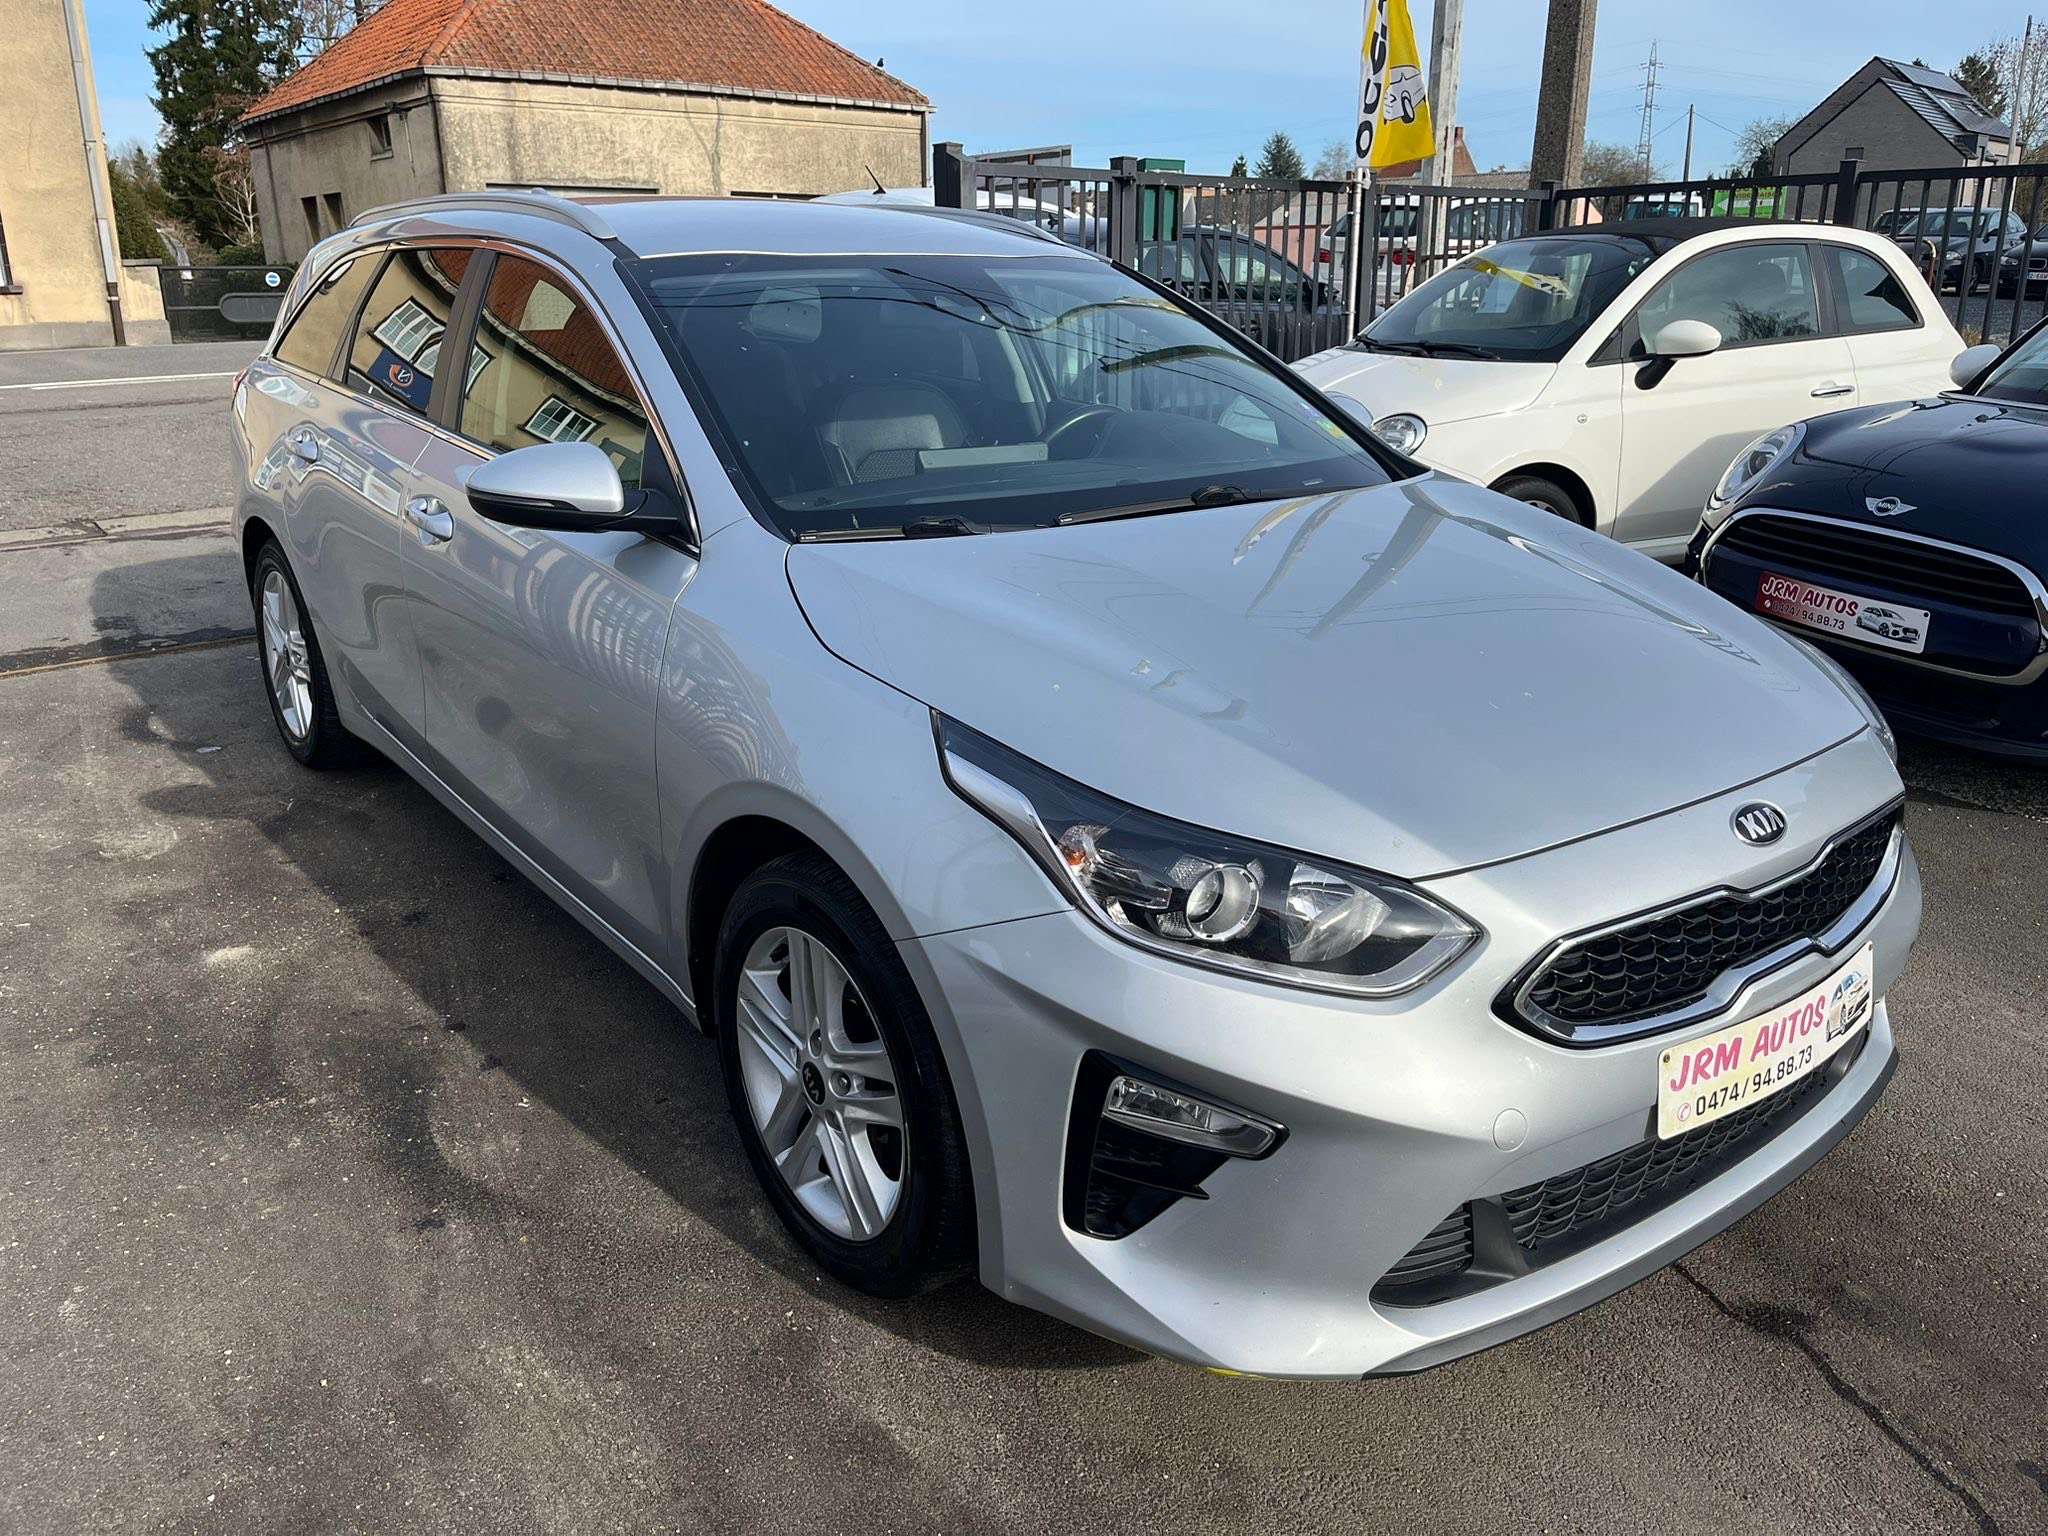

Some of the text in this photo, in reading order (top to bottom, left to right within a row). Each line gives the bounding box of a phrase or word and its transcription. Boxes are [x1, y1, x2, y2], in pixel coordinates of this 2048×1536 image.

[1762, 577, 1858, 617] JRM AUTOS
[1738, 808, 1783, 839] KIA
[1670, 995, 1826, 1092] JRM AUTOS
